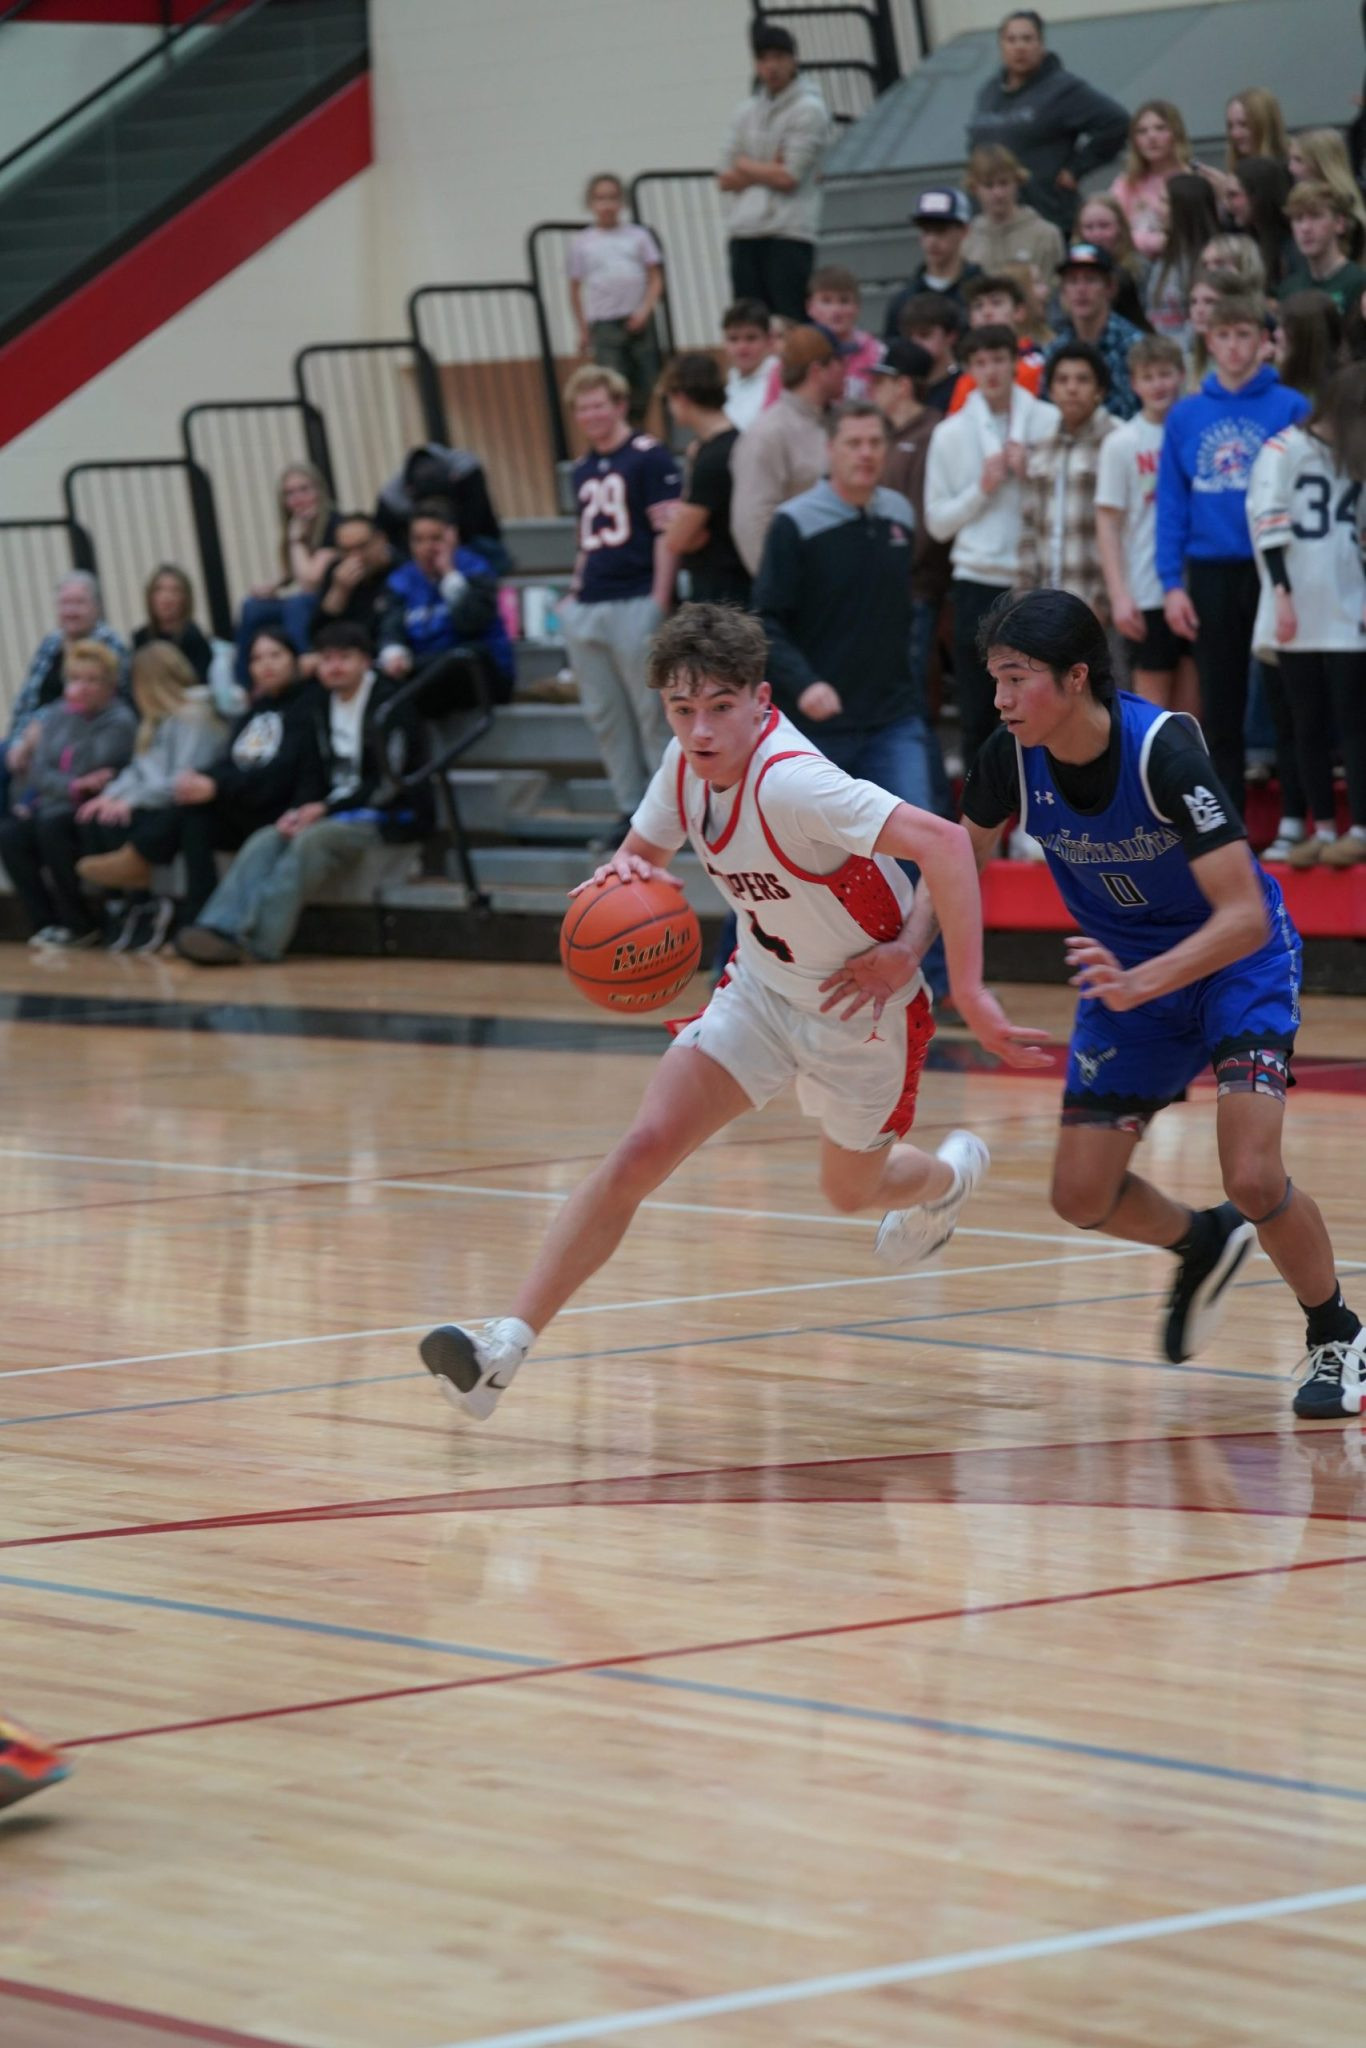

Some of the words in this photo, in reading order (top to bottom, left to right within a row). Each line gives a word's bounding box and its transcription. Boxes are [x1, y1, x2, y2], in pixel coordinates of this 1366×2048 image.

[578, 473, 630, 550] 29
[706, 862, 792, 902] PERS
[1099, 872, 1149, 908] 0
